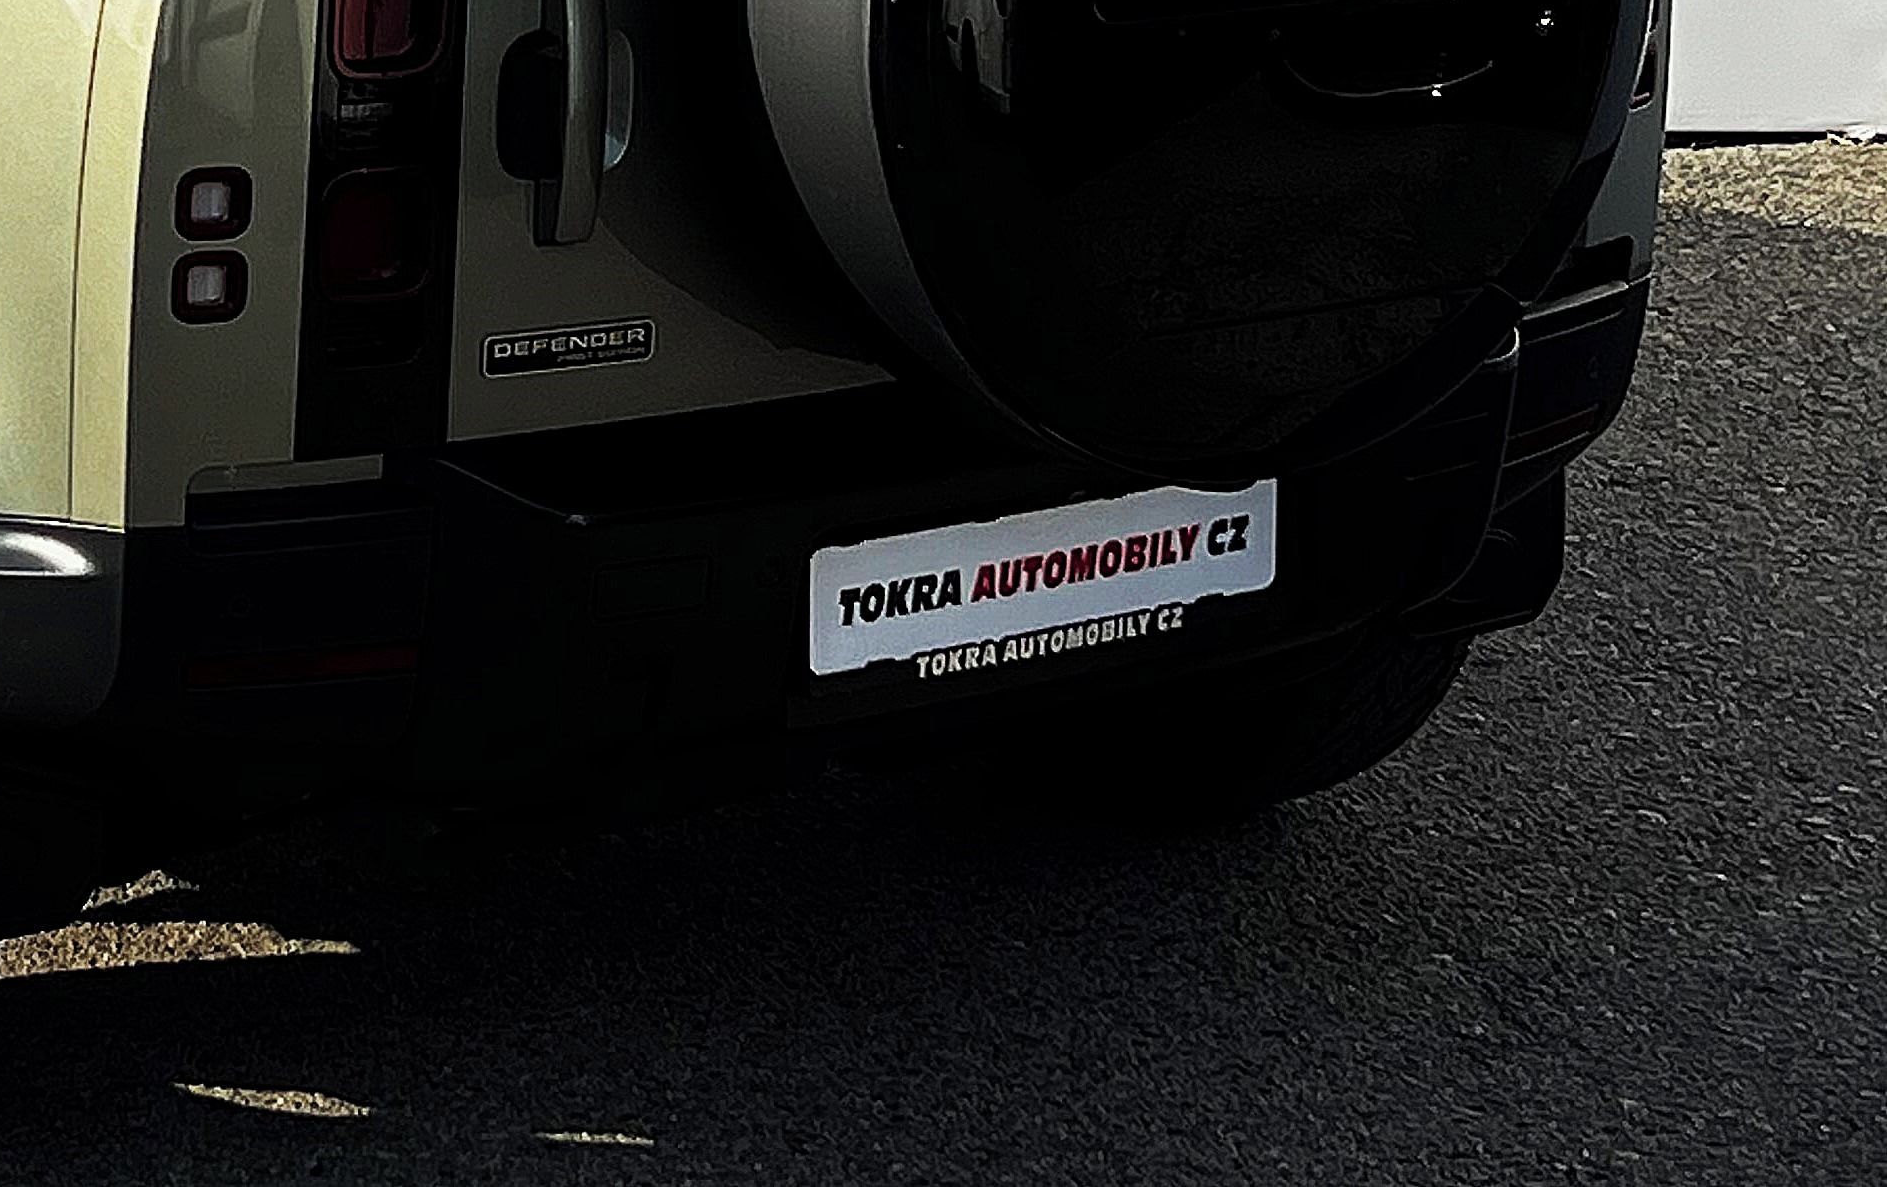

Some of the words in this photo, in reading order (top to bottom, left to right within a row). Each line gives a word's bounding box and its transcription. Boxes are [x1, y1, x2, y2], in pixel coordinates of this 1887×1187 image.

[493, 328, 646, 359] DEFENDER
[838, 569, 963, 627] TOKRA
[970, 523, 1201, 603] AUTOMOBILY
[1207, 514, 1250, 557] CZ
[916, 643, 998, 679] TOKRA
[1002, 612, 1151, 663] AUTOMOBILY
[1157, 606, 1184, 631] CZ
